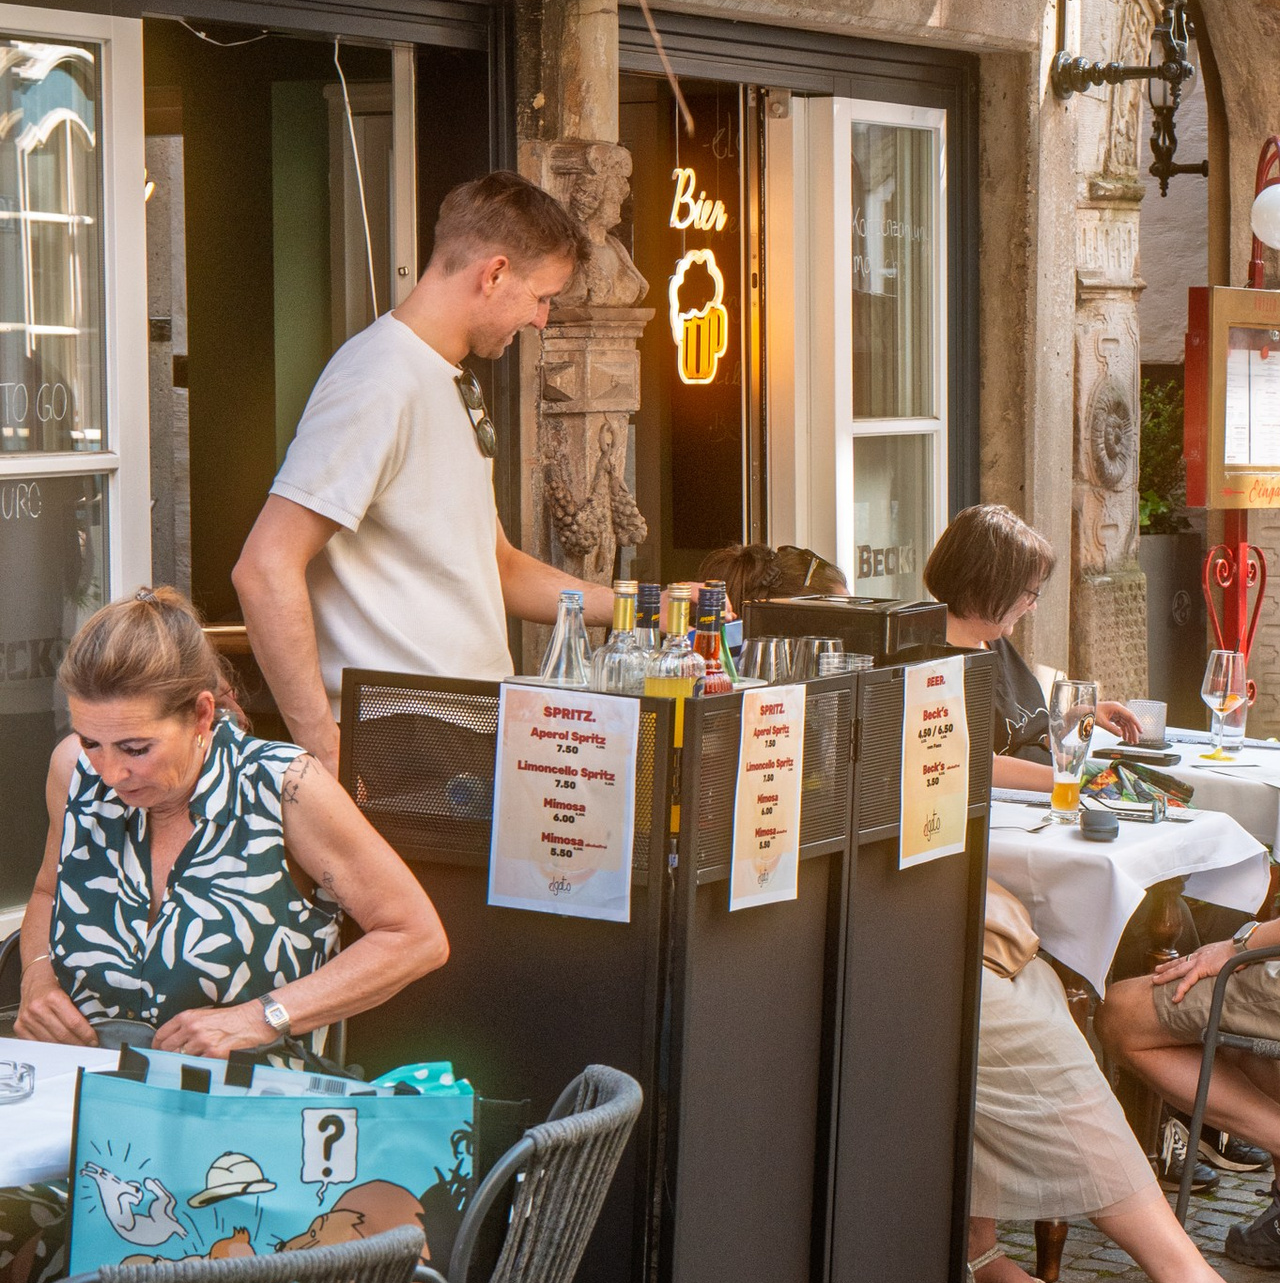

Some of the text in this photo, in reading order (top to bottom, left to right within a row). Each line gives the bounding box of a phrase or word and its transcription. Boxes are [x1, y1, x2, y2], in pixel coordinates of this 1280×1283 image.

[670, 167, 728, 232] Bier
[36, 382, 67, 422] GO
[543, 706, 596, 723] SPRITZ.
[923, 707, 949, 721] Beck's
[531, 727, 606, 745] Aperol Spritz
[753, 724, 790, 739] Aperol Spritz
[938, 723, 953, 735] 6.50
[556, 744, 579, 755] 7.50
[517, 760, 615, 781] Limoncello Spritz
[746, 757, 794, 772] Limoncello Spritz
[923, 762, 945, 775] Beck's
[555, 779, 576, 790] 7.50
[927, 777, 940, 787] 3.50
[543, 798, 586, 813] Mimosa
[757, 793, 779, 804] Mimosa
[553, 814, 575, 824] 6.00
[541, 832, 584, 847] Mimosa
[755, 827, 776, 838] Mimosa
[550, 848, 573, 858] 5.50
